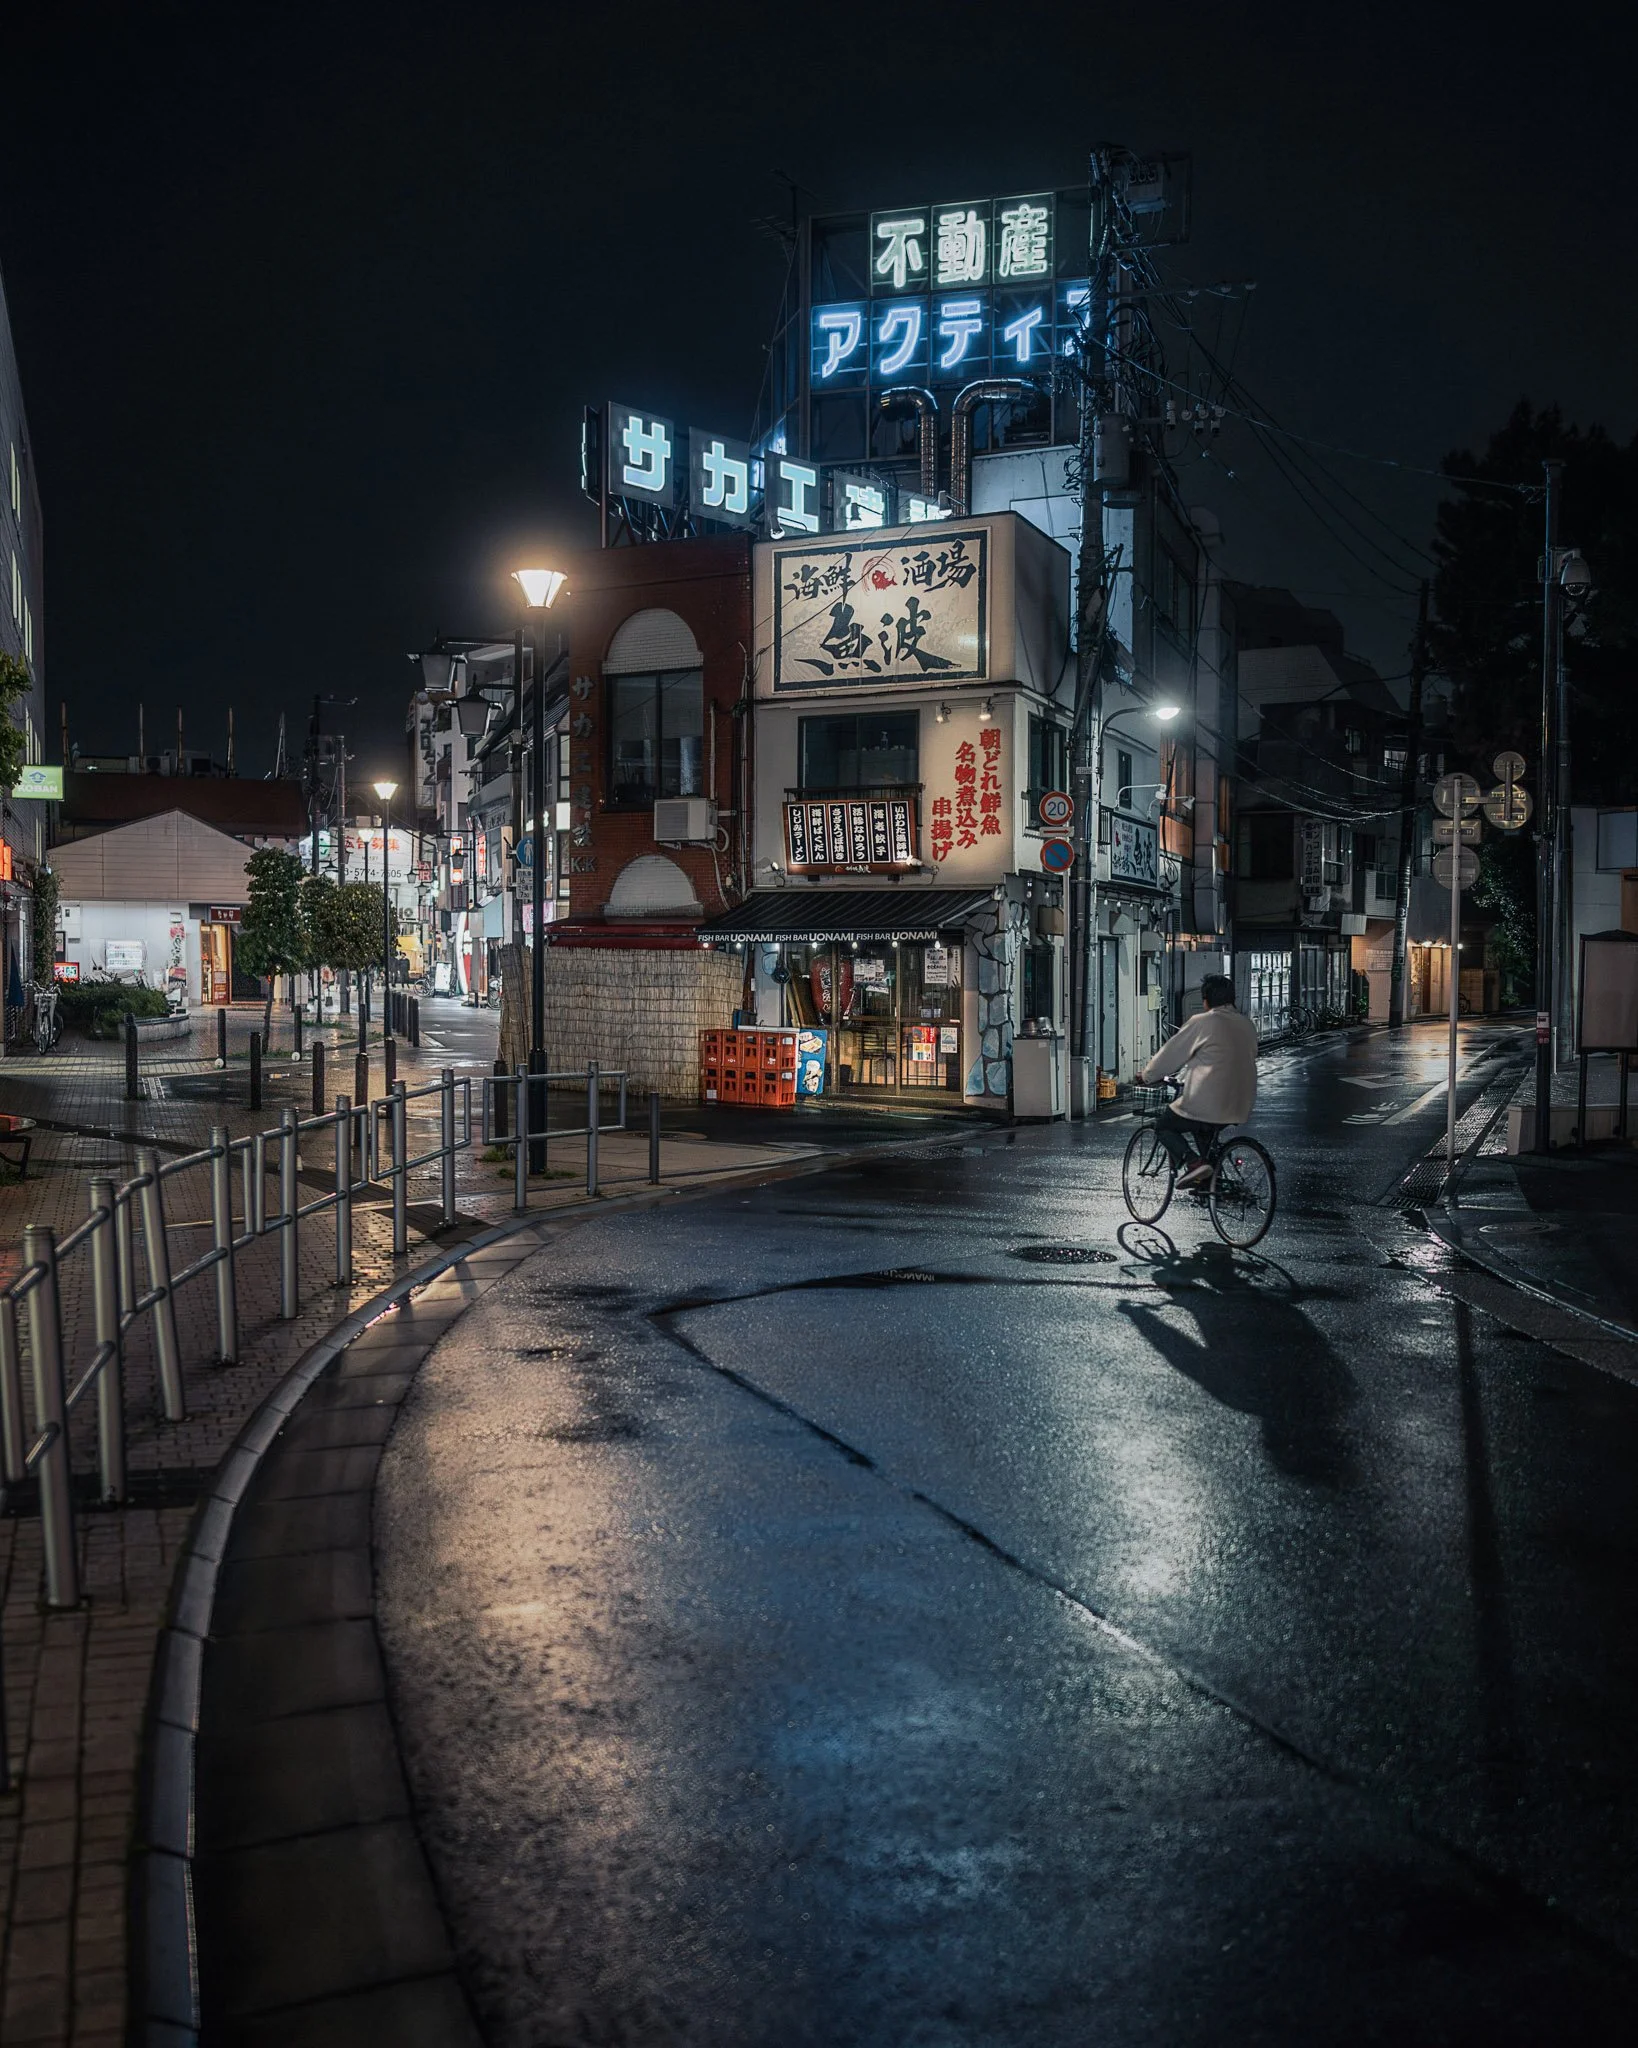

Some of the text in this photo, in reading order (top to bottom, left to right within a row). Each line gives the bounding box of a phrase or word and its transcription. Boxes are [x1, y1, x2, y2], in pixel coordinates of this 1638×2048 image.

[875, 202, 1050, 289] 不動産
[783, 538, 977, 602] 海鮮 酒場
[793, 596, 962, 676] 魚波
[18, 784, 58, 793] KOBAN
[955, 741, 979, 849] 名物煮込み
[979, 728, 1002, 836] 朝どれ鮮魚
[1047, 801, 1067, 816] 20
[792, 808, 805, 861] しじみラーメン
[930, 797, 954, 862] 串揚げ
[698, 934, 714, 942] FISH
[730, 933, 773, 942] UONAMI
[775, 934, 792, 942] FISH
[793, 934, 808, 942] BAR
[808, 932, 855, 941] UONAMI
[856, 933, 874, 941] FISH
[874, 932, 891, 940] BAR
[891, 931, 938, 940] UONAMI
